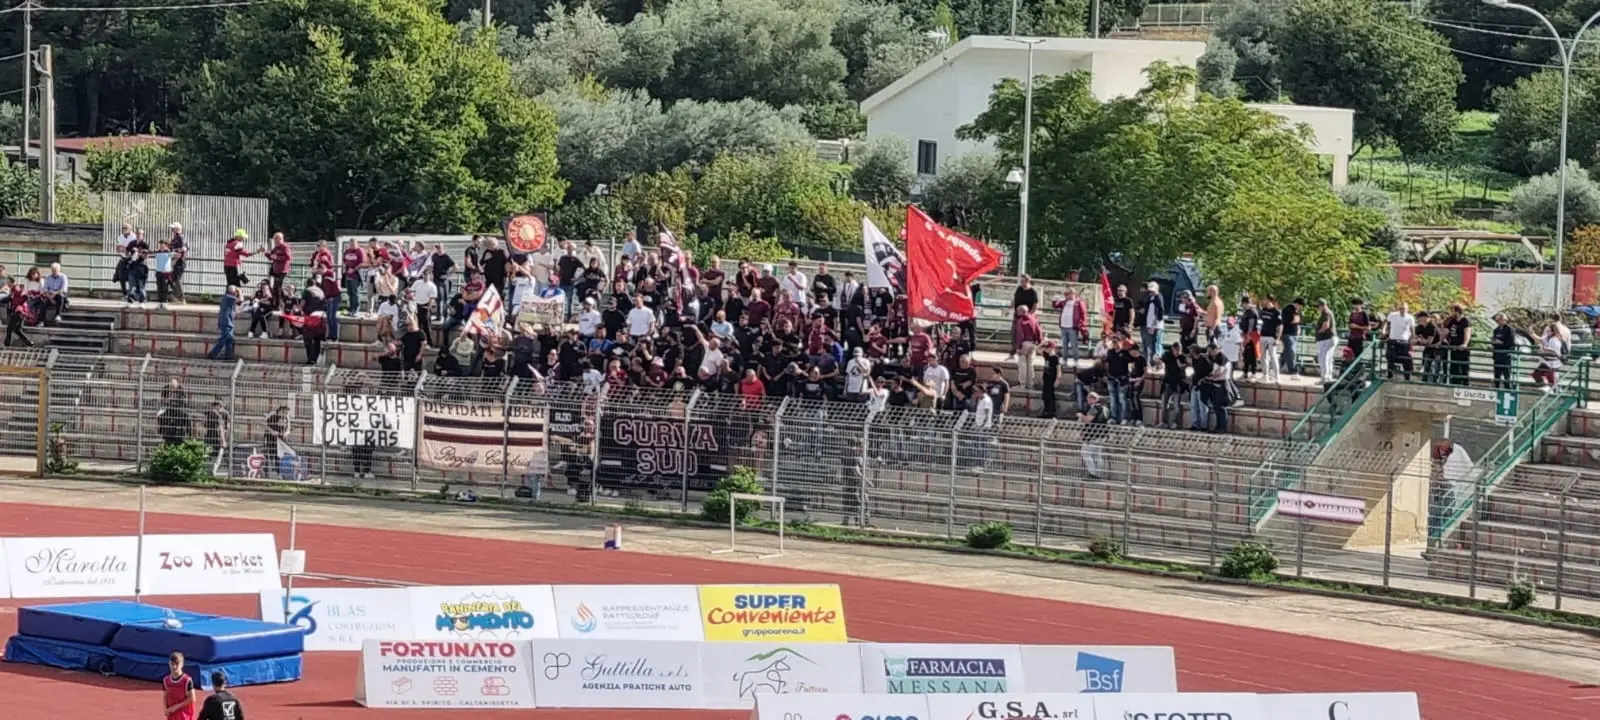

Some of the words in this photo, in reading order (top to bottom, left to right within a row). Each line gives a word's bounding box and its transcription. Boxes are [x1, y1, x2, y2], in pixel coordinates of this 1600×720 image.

[424, 402, 491, 418] DIFFIDATI
[325, 412, 360, 428] PER
[325, 428, 399, 448] ULTRAS
[614, 419, 718, 451] CURVA
[636, 448, 698, 476] SUD
[25, 547, 128, 574] Marotta
[159, 552, 193, 570] Zoo
[203, 552, 264, 570] Market
[734, 594, 806, 609] SUPER
[327, 604, 366, 617] BLAS
[707, 606, 837, 625] Conveniente
[742, 627, 806, 638] gruppoarena.it
[380, 642, 516, 658] FORTUNATO
[382, 664, 446, 673] MANUFATTI
[450, 665, 460, 673] IN
[463, 665, 517, 674] CEMENTO
[910, 660, 997, 675] FARMACIA
[582, 683, 620, 691] AGENZIA
[623, 683, 666, 691] PRATICHE
[668, 683, 692, 692] AUTO
[888, 680, 1007, 694] MESSANA
[1087, 668, 1120, 691] Bsf
[977, 701, 1058, 718] G.S.A.
[1062, 709, 1078, 719] srl
